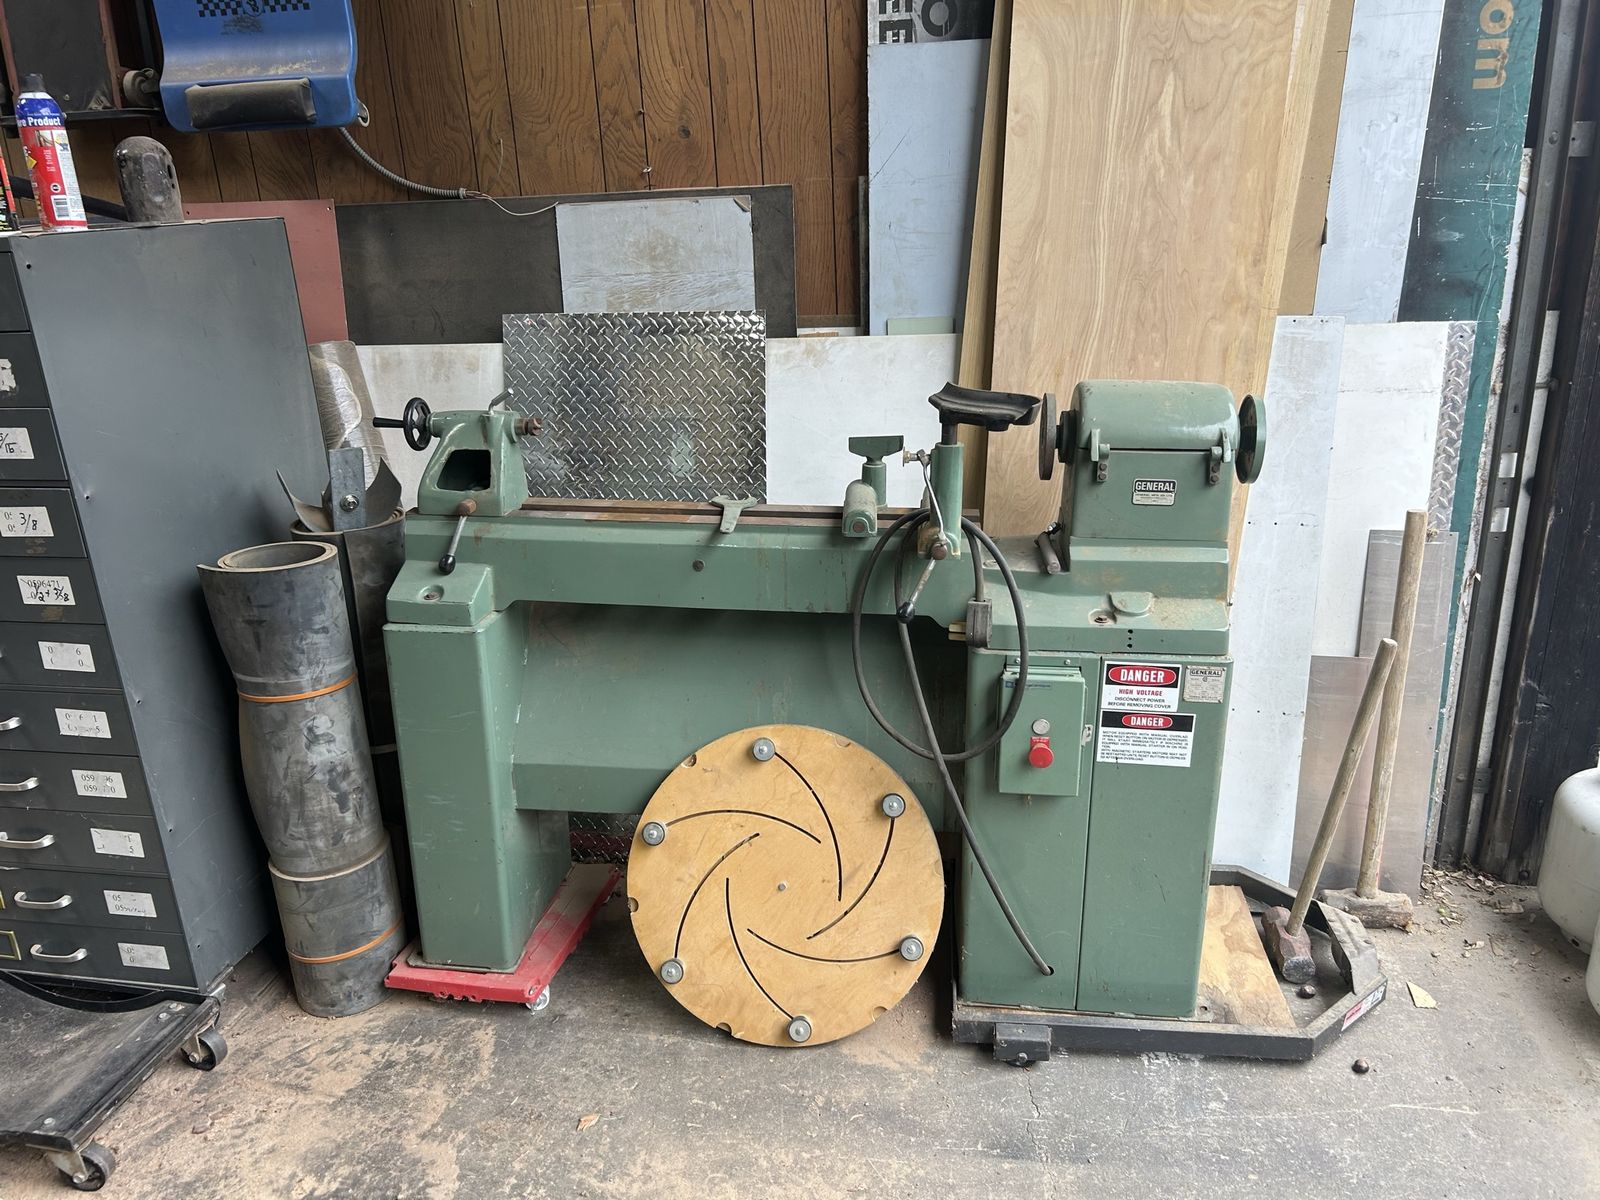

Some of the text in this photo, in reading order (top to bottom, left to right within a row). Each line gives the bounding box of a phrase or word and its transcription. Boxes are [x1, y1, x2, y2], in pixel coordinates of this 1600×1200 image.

[27, 116, 61, 126] Product
[1135, 481, 1175, 491] GENERAL
[19, 512, 37, 534] 3/8
[1120, 669, 1165, 683] DANGER
[1130, 716, 1164, 727] DANGER
